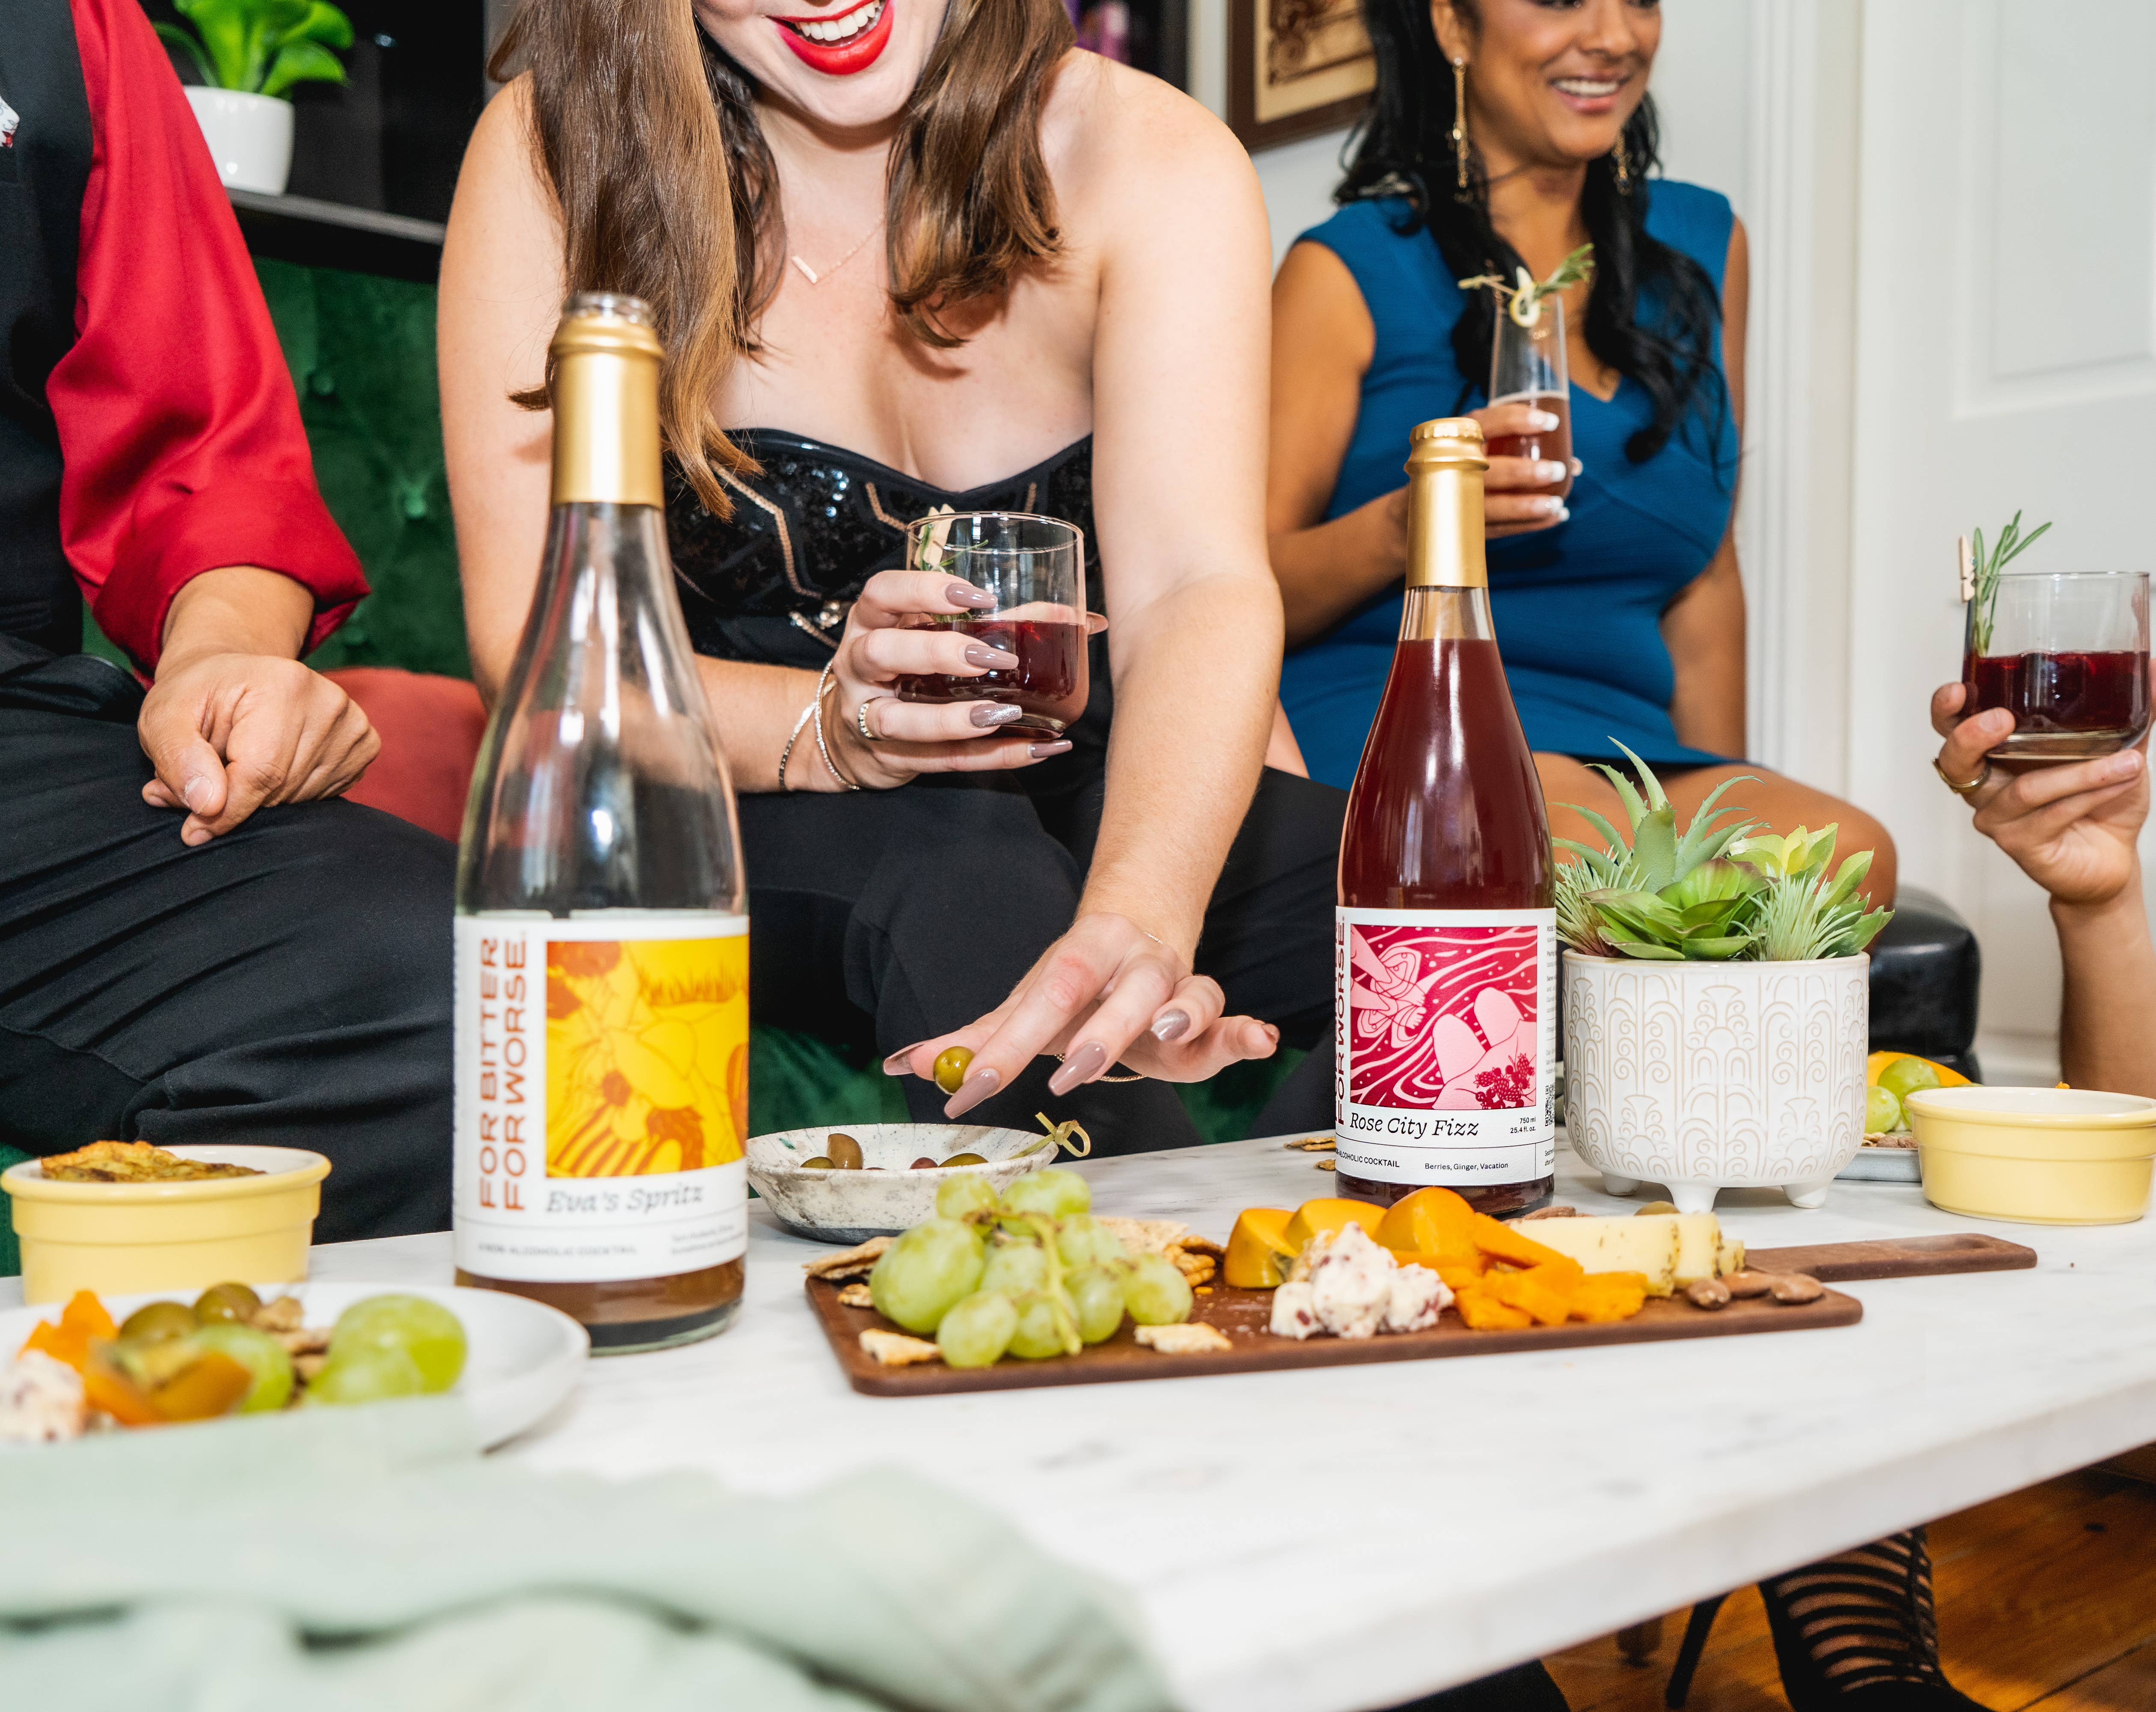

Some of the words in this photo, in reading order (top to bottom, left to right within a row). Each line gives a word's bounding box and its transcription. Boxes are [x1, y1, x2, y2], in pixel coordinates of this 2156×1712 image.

[479, 938, 498, 1102] BITTER
[503, 940, 526, 1105] WORSE
[1350, 1112, 1383, 1132] Rose
[1387, 1116, 1427, 1139] City
[1431, 1118, 1479, 1136] Fizz
[479, 1112, 498, 1209] FOR
[503, 1114, 526, 1211] FOR
[1364, 1157, 1400, 1168] COCKTAIL
[1425, 1163, 1452, 1171] Berries,
[547, 1190, 619, 1213] Eva's
[626, 1182, 703, 1214] Spritz
